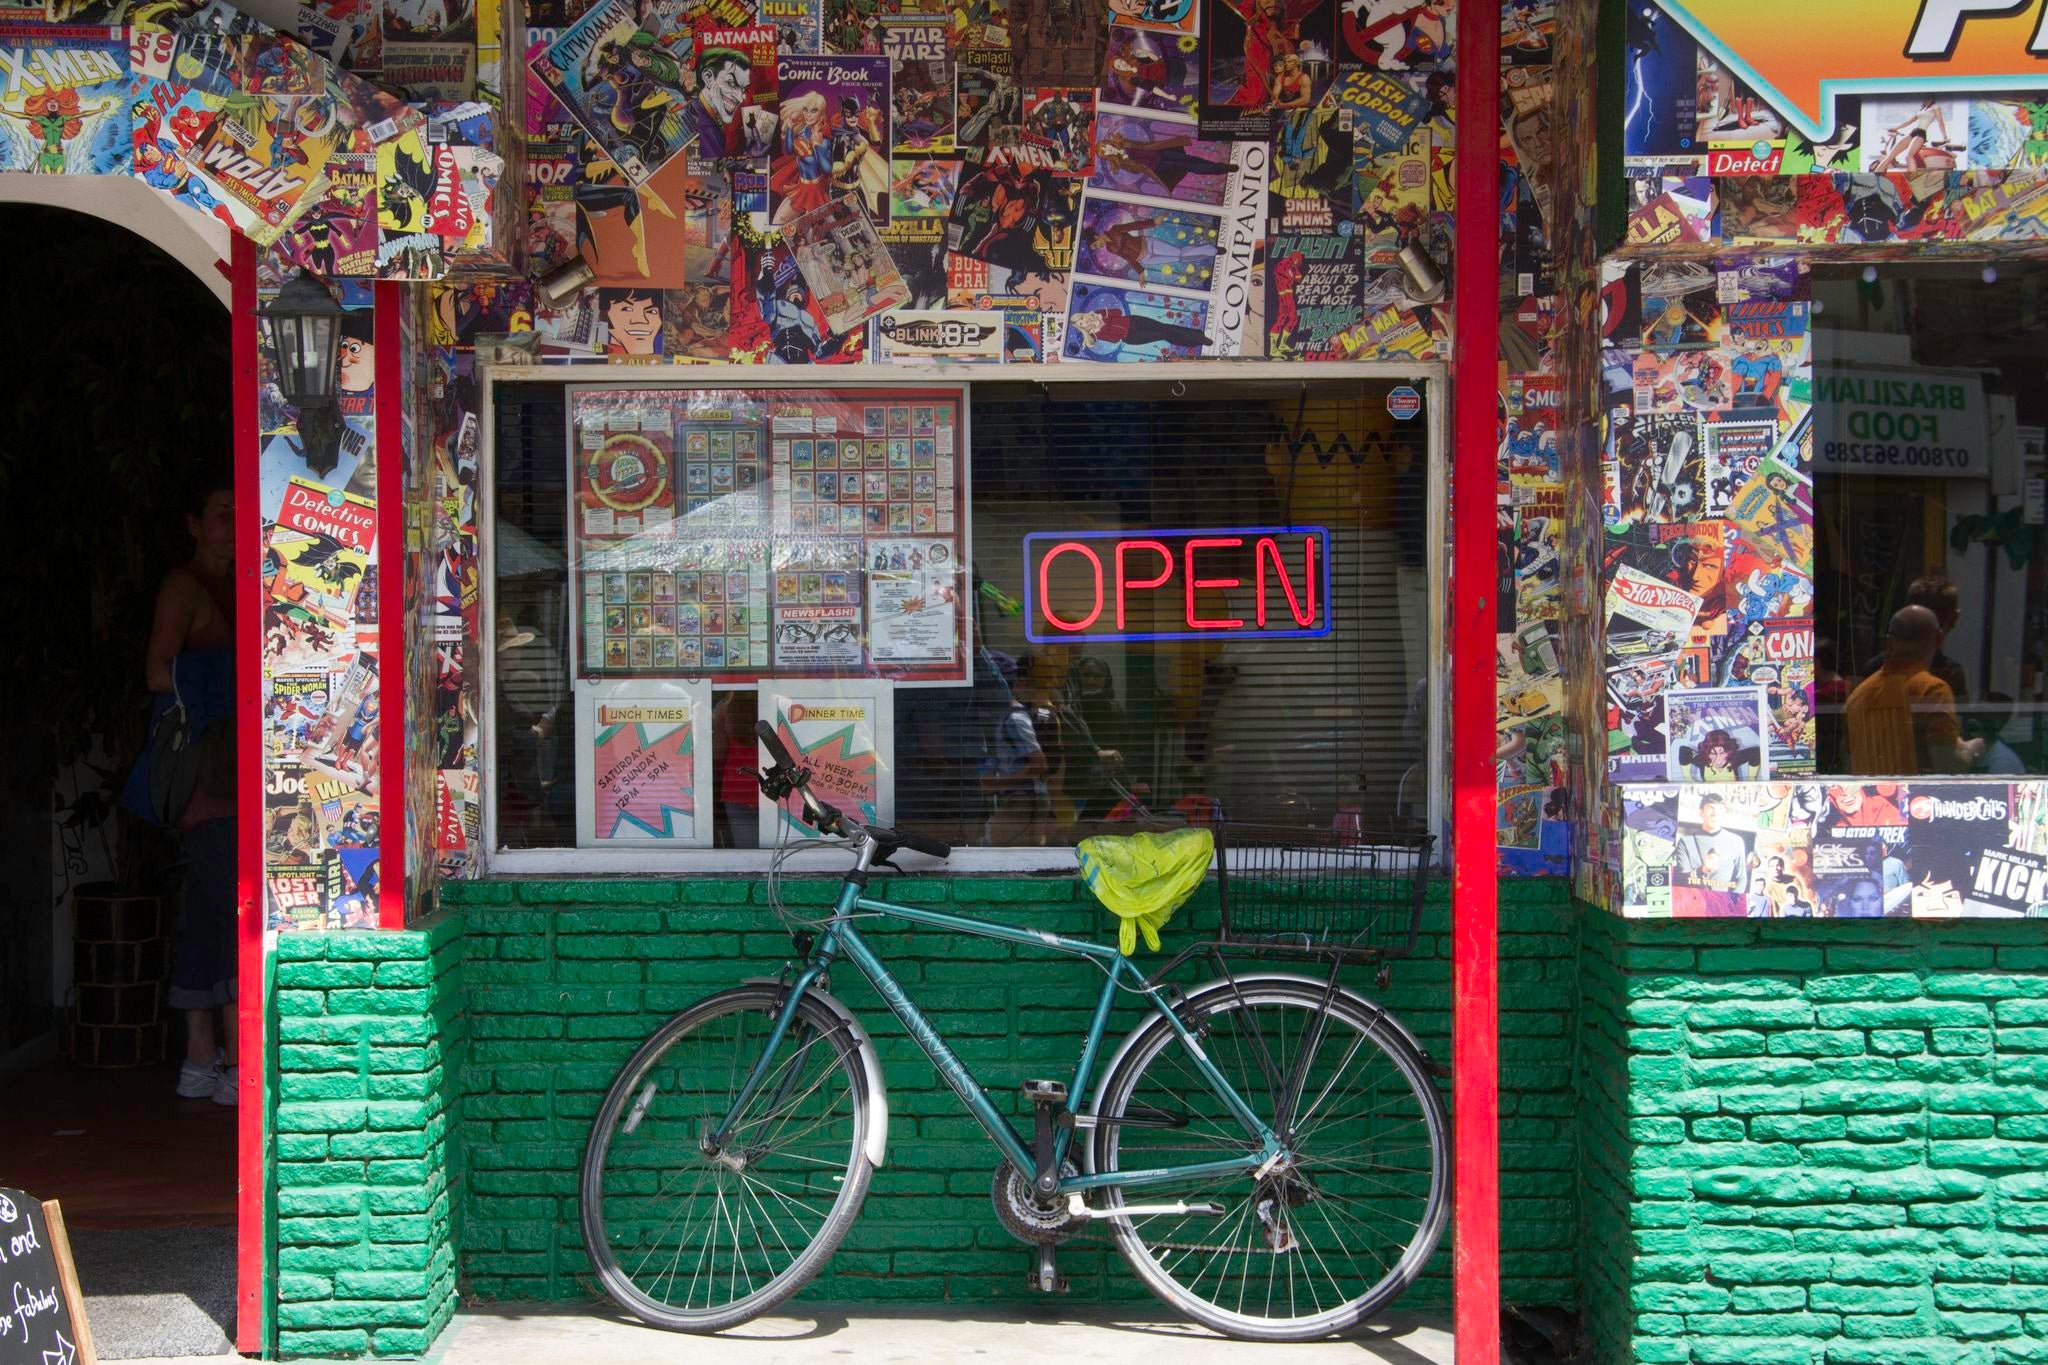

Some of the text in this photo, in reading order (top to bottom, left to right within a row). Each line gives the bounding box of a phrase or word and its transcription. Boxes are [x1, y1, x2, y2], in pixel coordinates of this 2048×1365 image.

[763, 2, 809, 16] HULK
[550, 3, 626, 72] CATWOMAN
[703, 30, 774, 46] BATMAN
[884, 27, 945, 43] STAR
[884, 44, 945, 60] WARS
[0, 48, 123, 99] X-MEN
[778, 62, 869, 85] Comic Book
[1347, 71, 1406, 103] FLASH
[1342, 87, 1414, 127] GORDON
[203, 142, 305, 200] ATOM
[1715, 154, 1779, 173] Detect
[331, 169, 375, 186] BATMAN
[224, 175, 262, 207] SHOWCASE
[1225, 173, 1235, 207] DONNA
[1285, 198, 1331, 212] THING
[1962, 188, 1998, 222] BAT
[1282, 212, 1333, 227] SWAMP
[362, 250, 376, 260] HER
[1212, 215, 1228, 294] MARTHA JONES
[1302, 274, 1359, 285] ABOUT TO
[1308, 264, 1354, 274] YOU ARE
[1296, 285, 1352, 295] READ OF
[1297, 294, 1356, 305] THE MOST
[1205, 304, 1215, 331] TYLER
[1297, 306, 1364, 331] TRAGIC
[1372, 307, 1400, 330] MAN
[1305, 342, 1324, 351] THE
[1340, 326, 1371, 350] BAT
[290, 490, 373, 529] Detective
[292, 512, 360, 545] COMICS
[1040, 535, 1315, 631] OPEN
[782, 609, 855, 619] NEWSFLASH!
[1789, 619, 1812, 627] COMICS
[274, 682, 327, 696] SPIDER-WOMAN
[647, 709, 683, 720] TIMES
[788, 704, 836, 724] DINNER
[598, 746, 643, 790] SATURDAY
[621, 752, 658, 787] SUNDAY
[801, 756, 855, 778] ALL WEEK
[615, 761, 670, 810] 12PM 5PM
[821, 772, 868, 793] 10.30PM
[1879, 826, 1908, 843] TREK
[1984, 848, 2039, 869] MARK MILLAR
[1687, 877, 1737, 888] THE VULCANS
[11, 1213, 41, 1257] and
